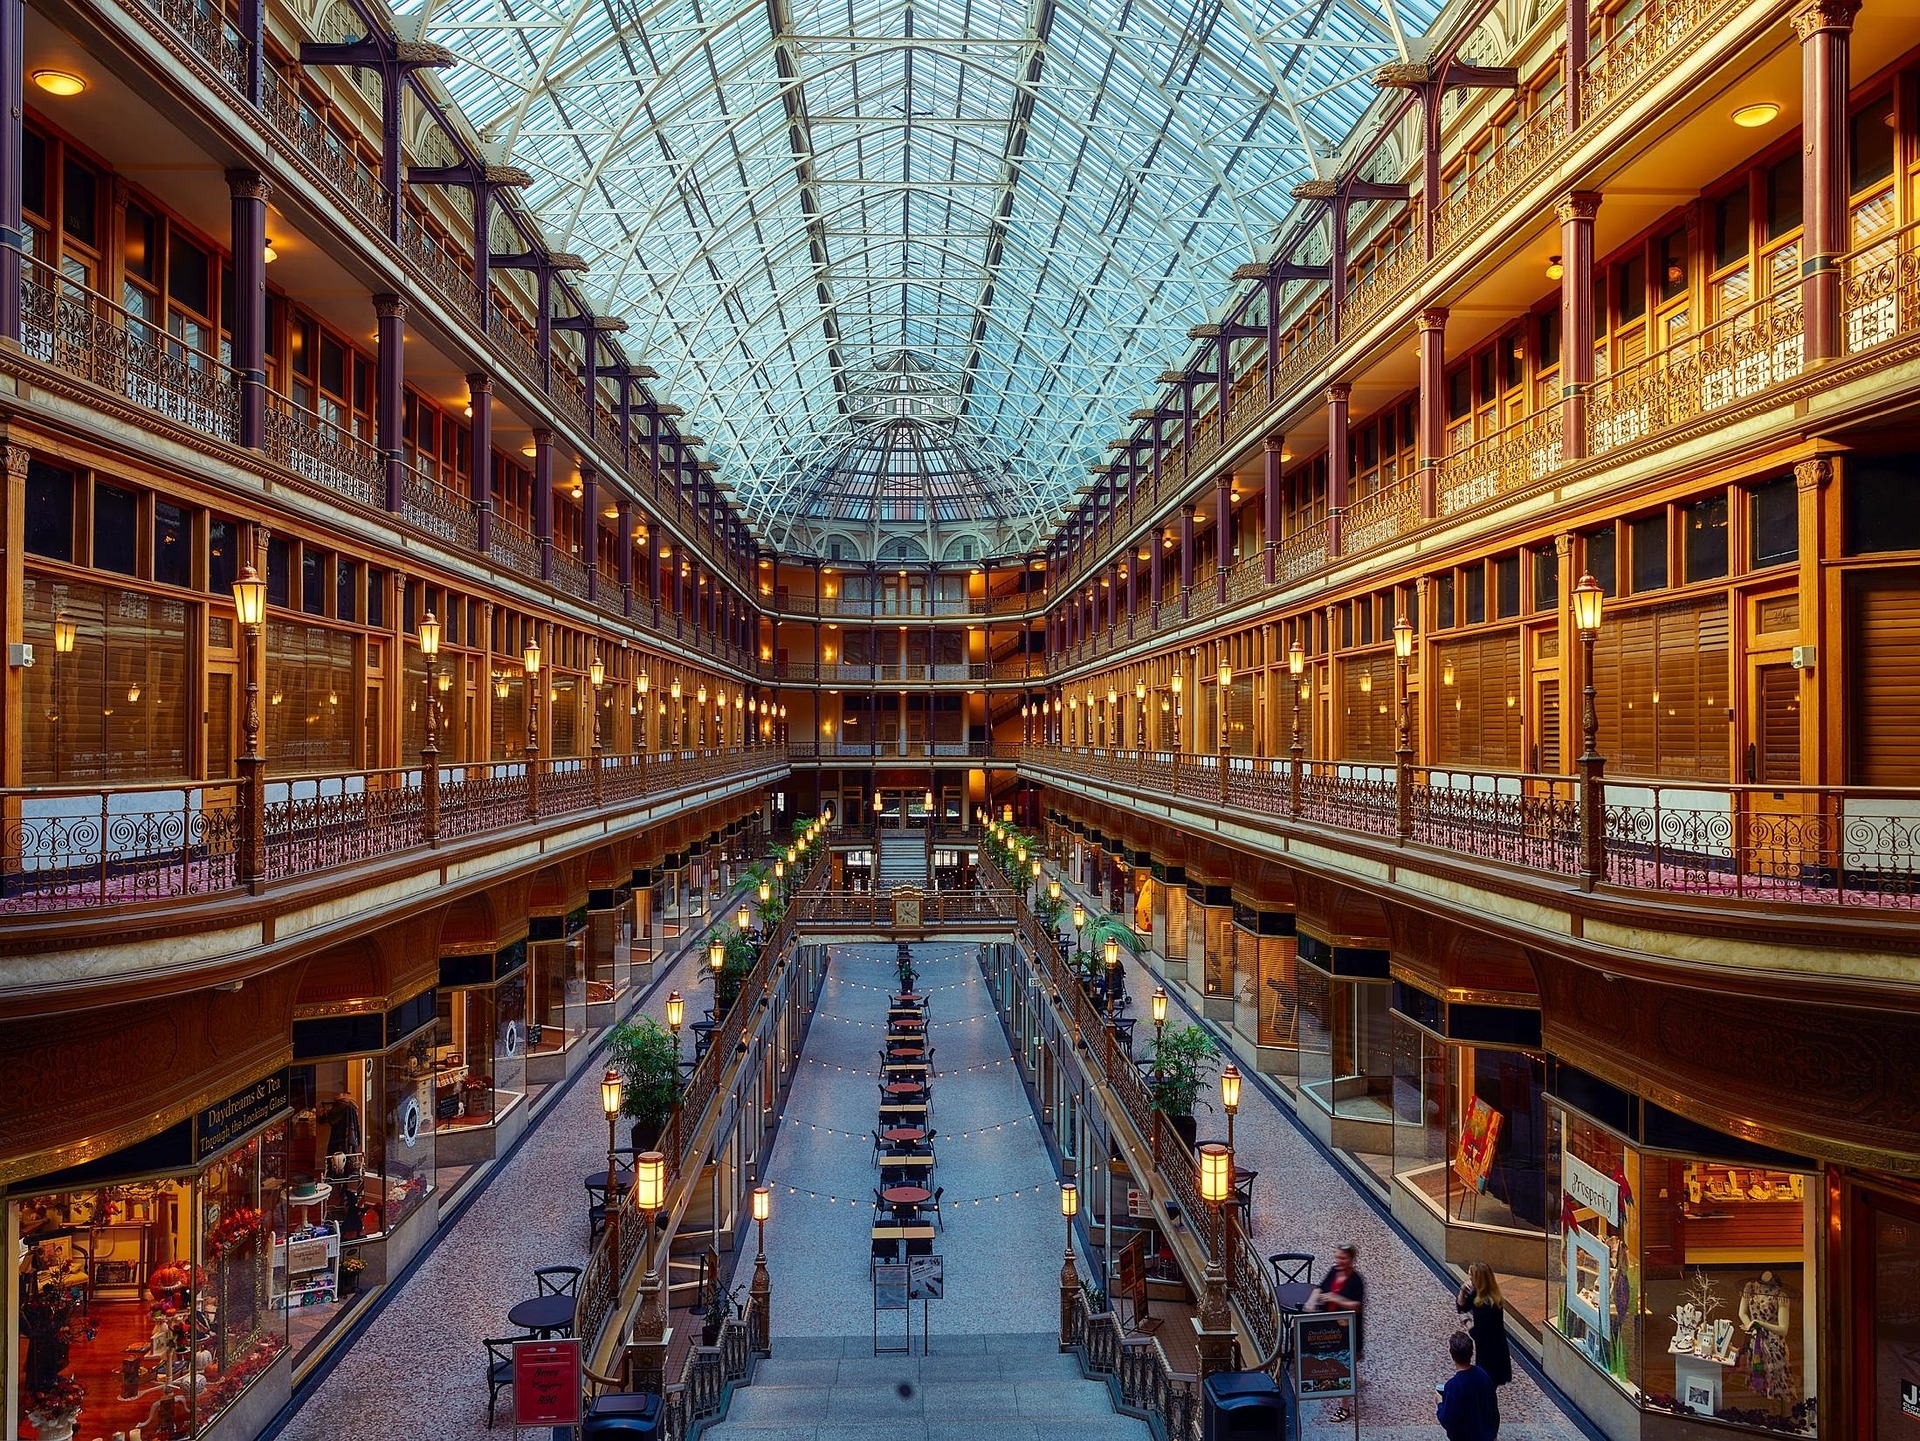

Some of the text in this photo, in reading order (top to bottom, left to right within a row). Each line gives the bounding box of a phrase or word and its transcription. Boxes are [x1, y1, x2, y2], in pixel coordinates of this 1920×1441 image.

[200, 1095, 287, 1152] Through the Looking Glass
[208, 1078, 281, 1127] Daydreams & Tea
[1571, 1172, 1612, 1219] Prosperity
[1903, 1385, 1920, 1405] J
